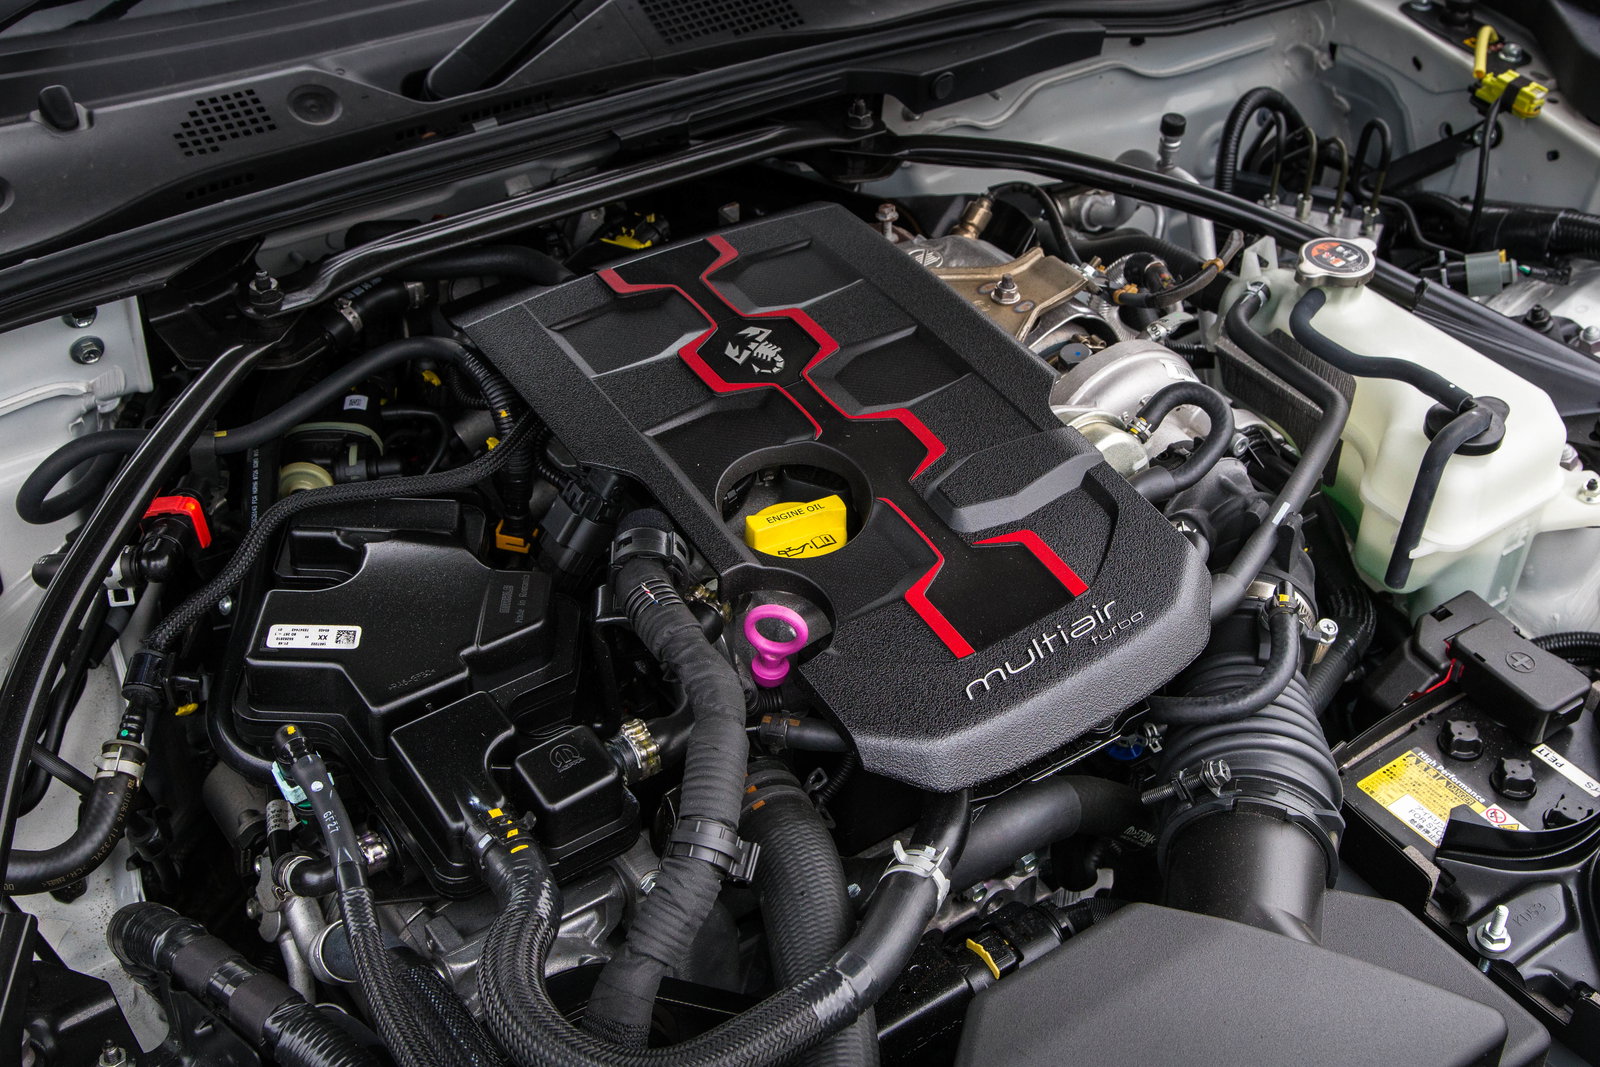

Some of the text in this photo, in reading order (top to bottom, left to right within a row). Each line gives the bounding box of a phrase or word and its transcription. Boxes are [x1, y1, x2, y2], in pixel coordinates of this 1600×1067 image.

[766, 503, 825, 524] ENGINE OIL
[1091, 611, 1144, 645] turbo
[965, 600, 1115, 700] multiair
[1417, 751, 1437, 768] High
[1437, 763, 1486, 804] Performance
[1446, 784, 1475, 805] DANGER
[1408, 809, 1427, 825] FOR
